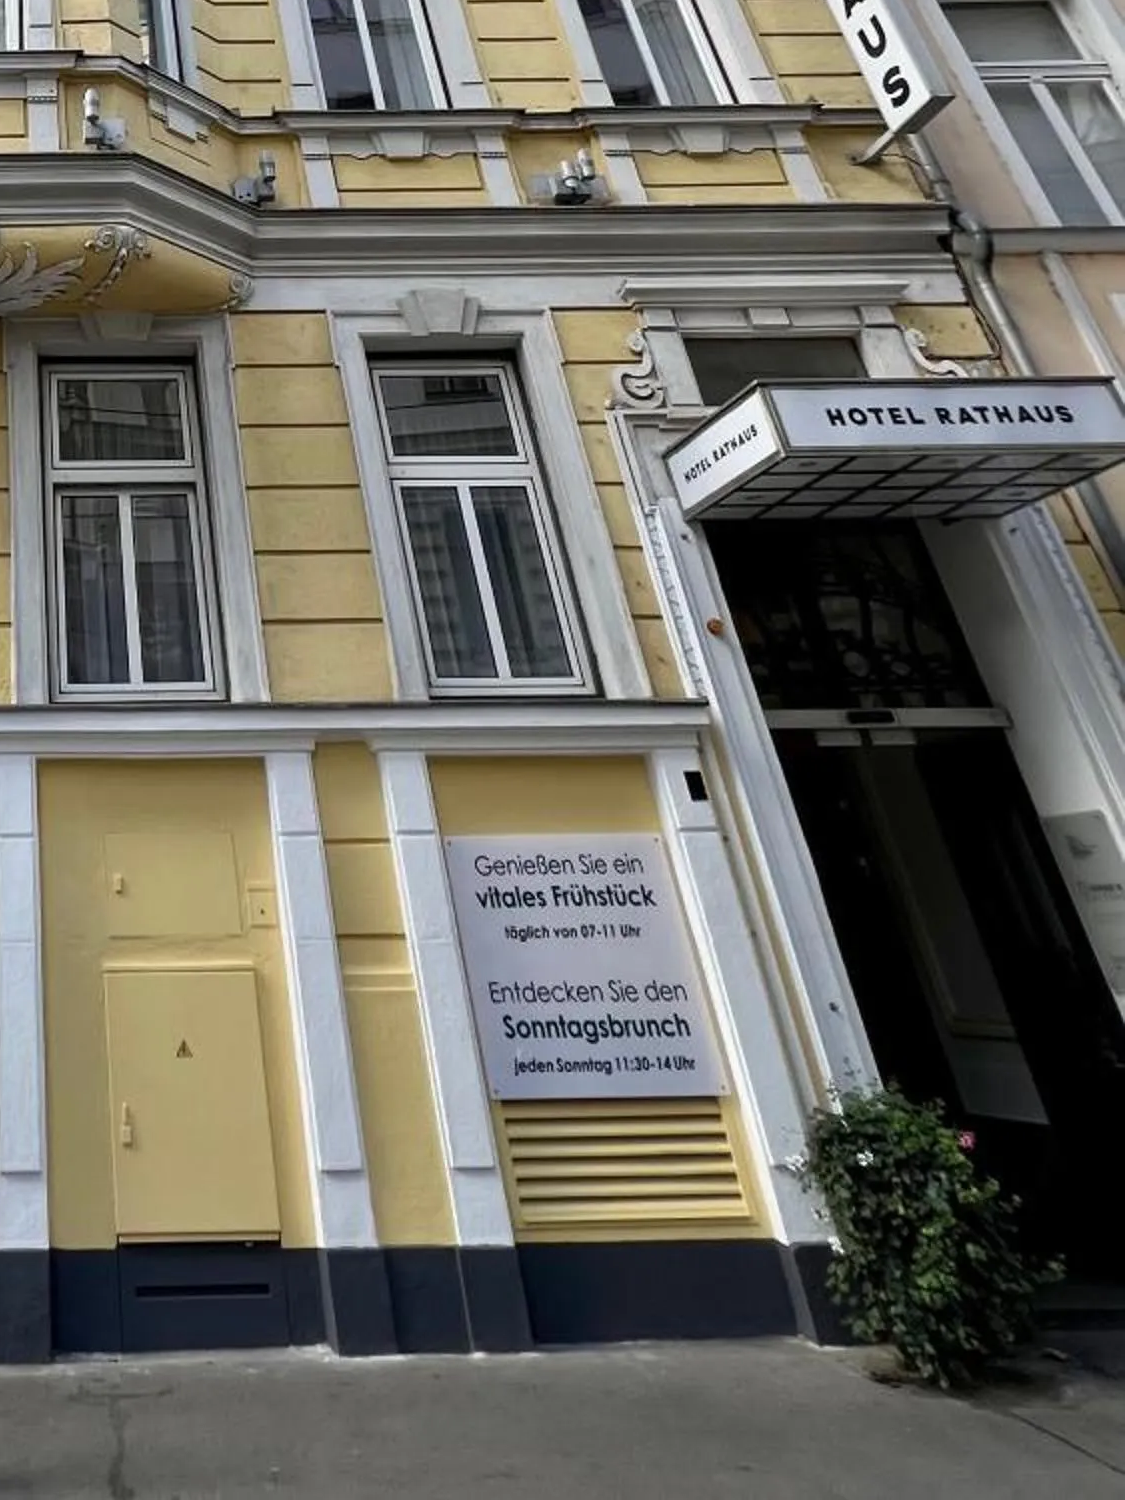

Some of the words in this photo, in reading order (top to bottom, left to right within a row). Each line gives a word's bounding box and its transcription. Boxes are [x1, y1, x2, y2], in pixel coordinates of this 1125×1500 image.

[826, 407, 926, 427] HOTEL
[936, 405, 1075, 425] RATHAUS
[683, 455, 712, 484] HOTEL
[712, 423, 758, 462] RATHAUS
[474, 854, 575, 877] Genießen
[578, 854, 608, 875] Sie
[613, 853, 643, 874] ein
[476, 885, 547, 909] vitales
[551, 883, 657, 908] Frühstück
[504, 924, 550, 942] täglich
[553, 927, 578, 939] von
[580, 924, 616, 939] 07-11
[620, 924, 641, 939] Uhr
[488, 980, 604, 1004] Entdecken
[608, 979, 640, 1002] Sie
[644, 980, 688, 1002] den
[502, 1013, 691, 1045] Sonntagsbrunch
[514, 1056, 554, 1076] jeden
[556, 1056, 613, 1075] Sonntag
[615, 1055, 672, 1072] 11:30-14
[674, 1055, 695, 1071] Uhr
